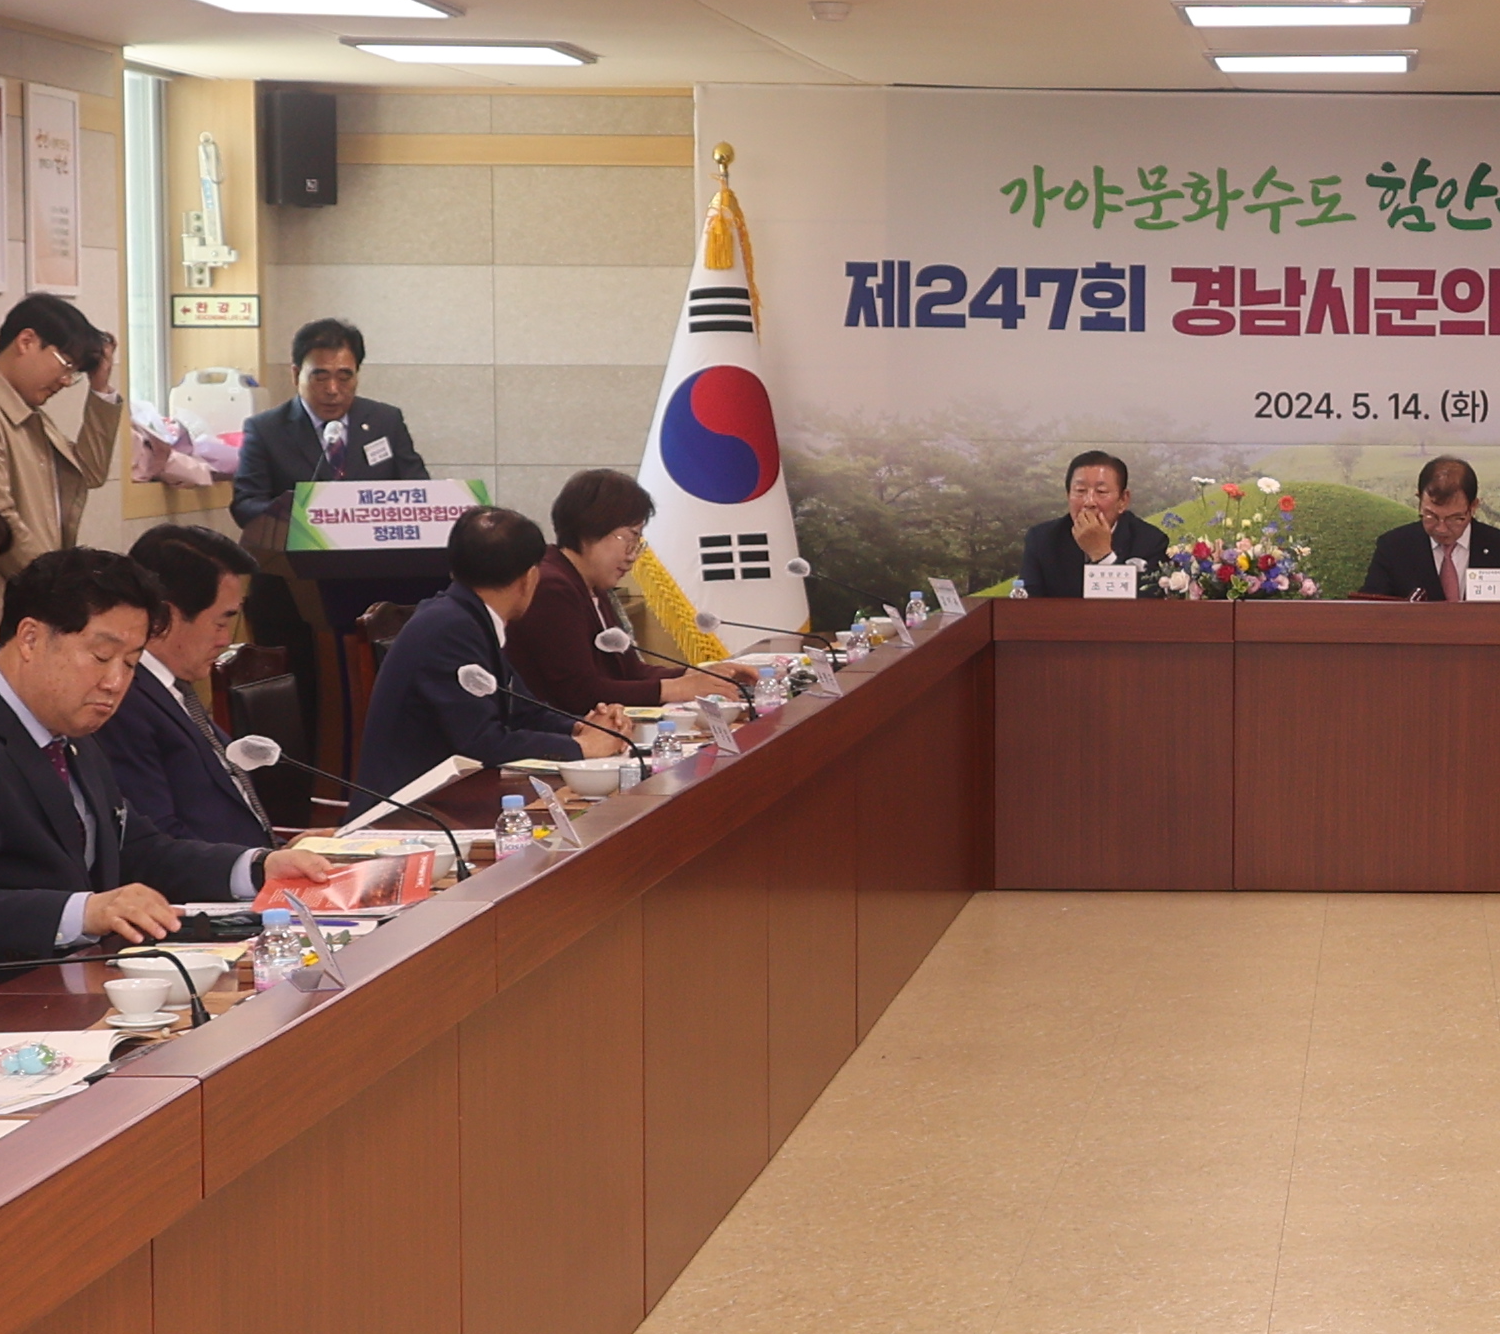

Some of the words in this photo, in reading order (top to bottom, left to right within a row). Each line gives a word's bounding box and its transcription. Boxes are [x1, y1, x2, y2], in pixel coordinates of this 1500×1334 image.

[999, 164, 1357, 235] 가야문화수도
[844, 259, 1147, 333] 제247회
[1253, 391, 1343, 421] 2024.
[1352, 392, 1379, 421] 5.
[1388, 392, 1431, 421] 14.
[1440, 389, 1490, 424] (화)
[357, 488, 428, 505] 제247회
[372, 525, 420, 542] 정례회
